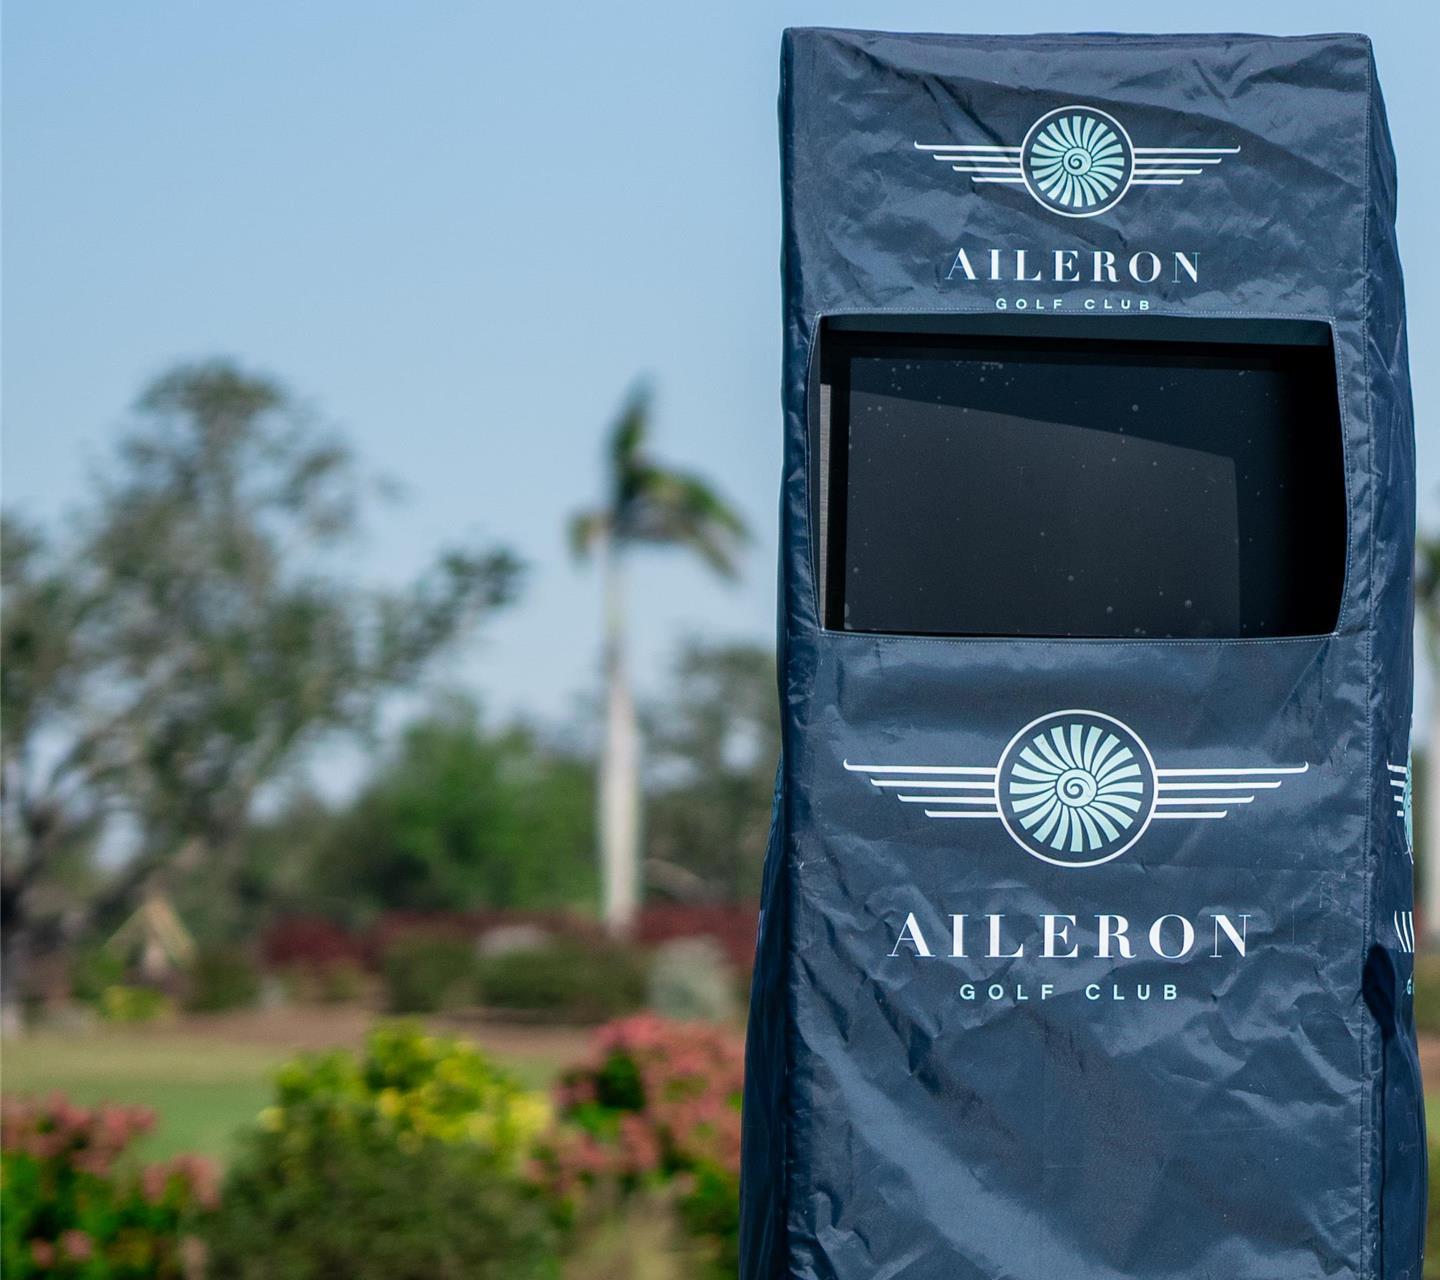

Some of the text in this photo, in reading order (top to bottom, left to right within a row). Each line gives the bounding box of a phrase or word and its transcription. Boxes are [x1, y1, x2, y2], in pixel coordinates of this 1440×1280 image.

[944, 247, 1201, 284] AILERON
[995, 297, 1150, 311] GOLF CLUB
[886, 911, 1253, 959] AILERON
[959, 983, 1178, 1001] GOLF CLUB
